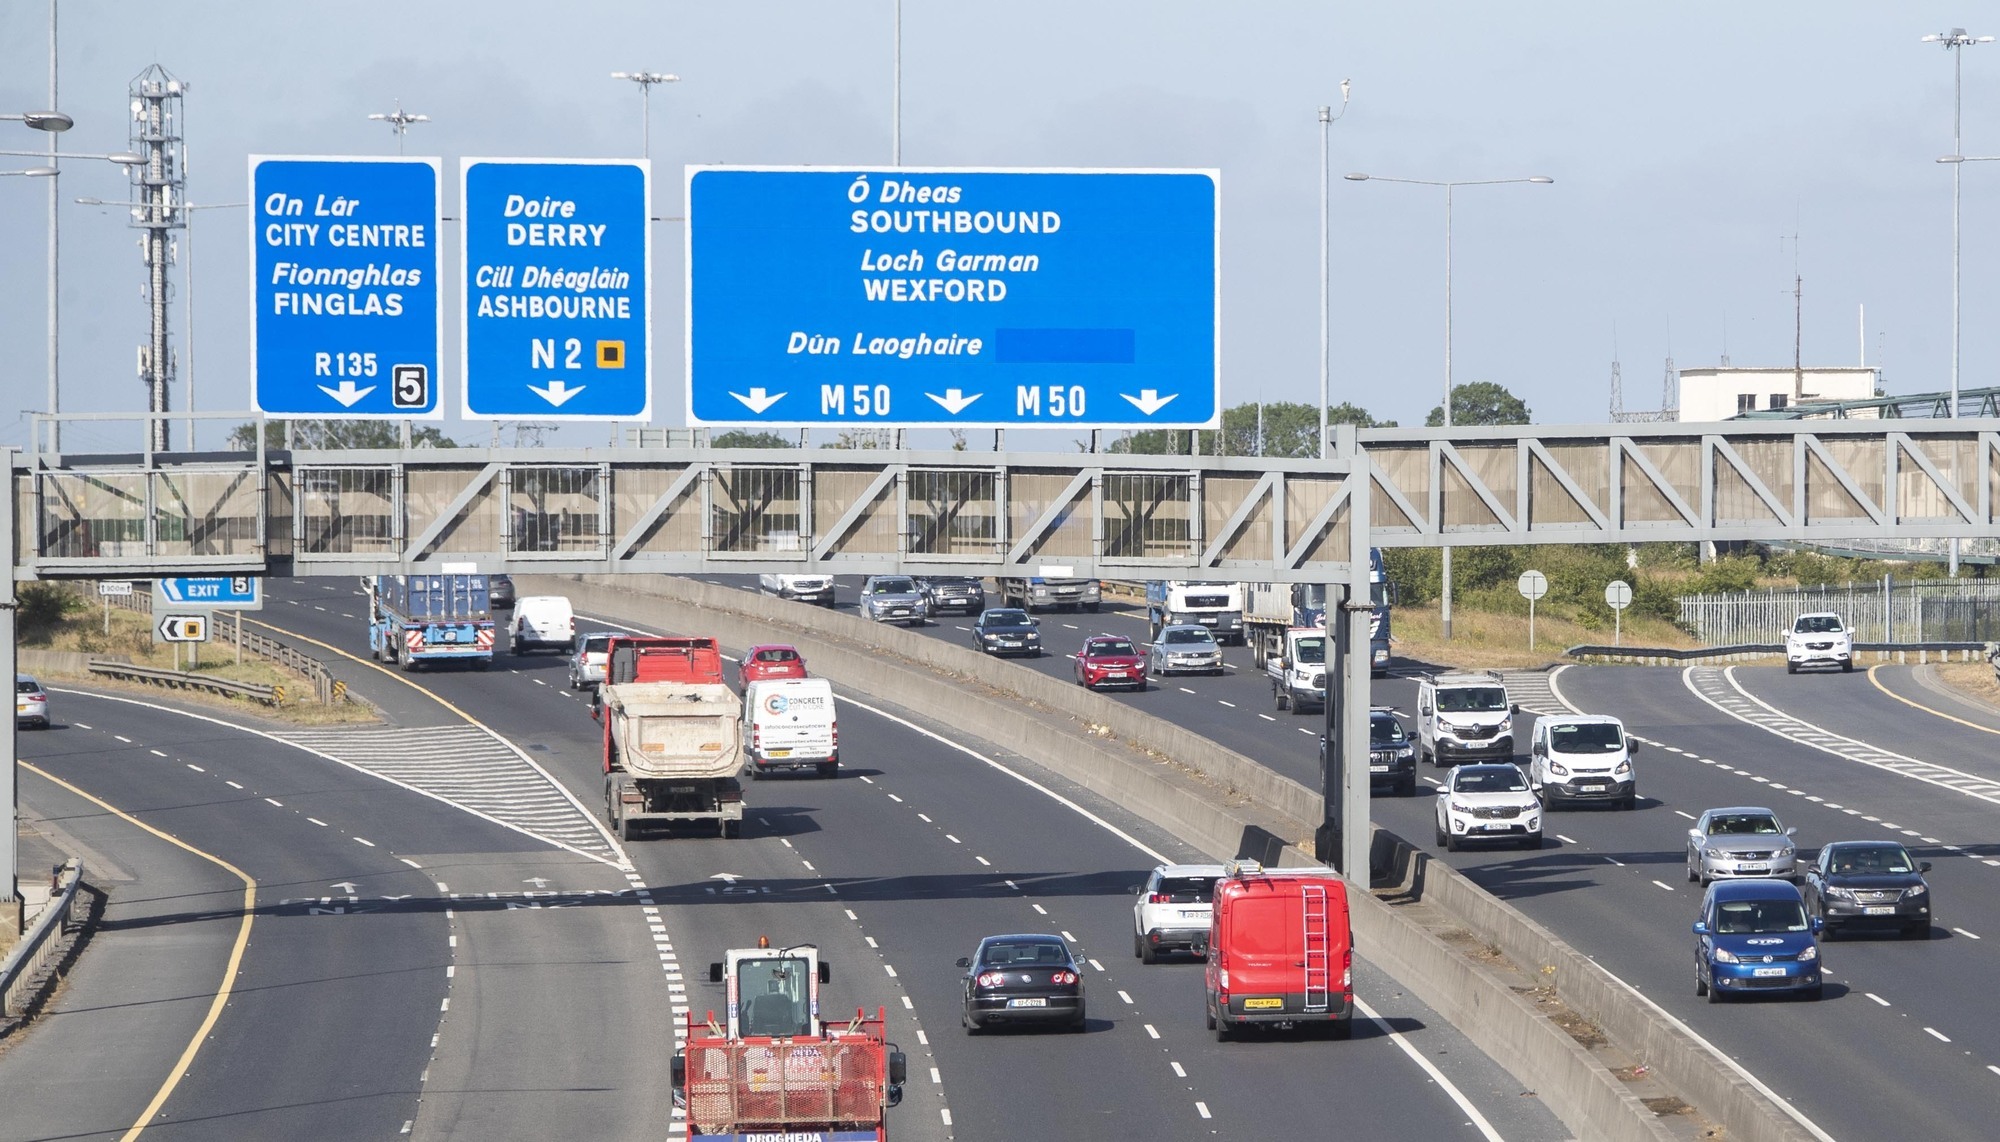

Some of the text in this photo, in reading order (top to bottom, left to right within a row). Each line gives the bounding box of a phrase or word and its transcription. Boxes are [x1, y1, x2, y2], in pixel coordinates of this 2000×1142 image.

[847, 174, 962, 204] Ó Dheas
[314, 194, 360, 217] Lár
[504, 194, 576, 218] Doire
[850, 209, 1061, 234] SOUTHBOUND
[265, 223, 425, 247] CITY CENTRE
[507, 223, 607, 247] DERRY
[860, 249, 1039, 272] Loch Garman
[272, 262, 422, 290] Fionnghlas
[475, 265, 630, 293] Cill Dhéagláin
[863, 278, 1007, 302] WEXFORD
[274, 292, 403, 316] FINGLAS
[477, 294, 631, 319] ASHBOURNE
[787, 331, 983, 359] Dún Laoghaire
[398, 370, 422, 403] 5
[187, 584, 220, 598] EXIT
[234, 577, 247, 593] 5
[746, 1132, 824, 1142] DROGHEDA
